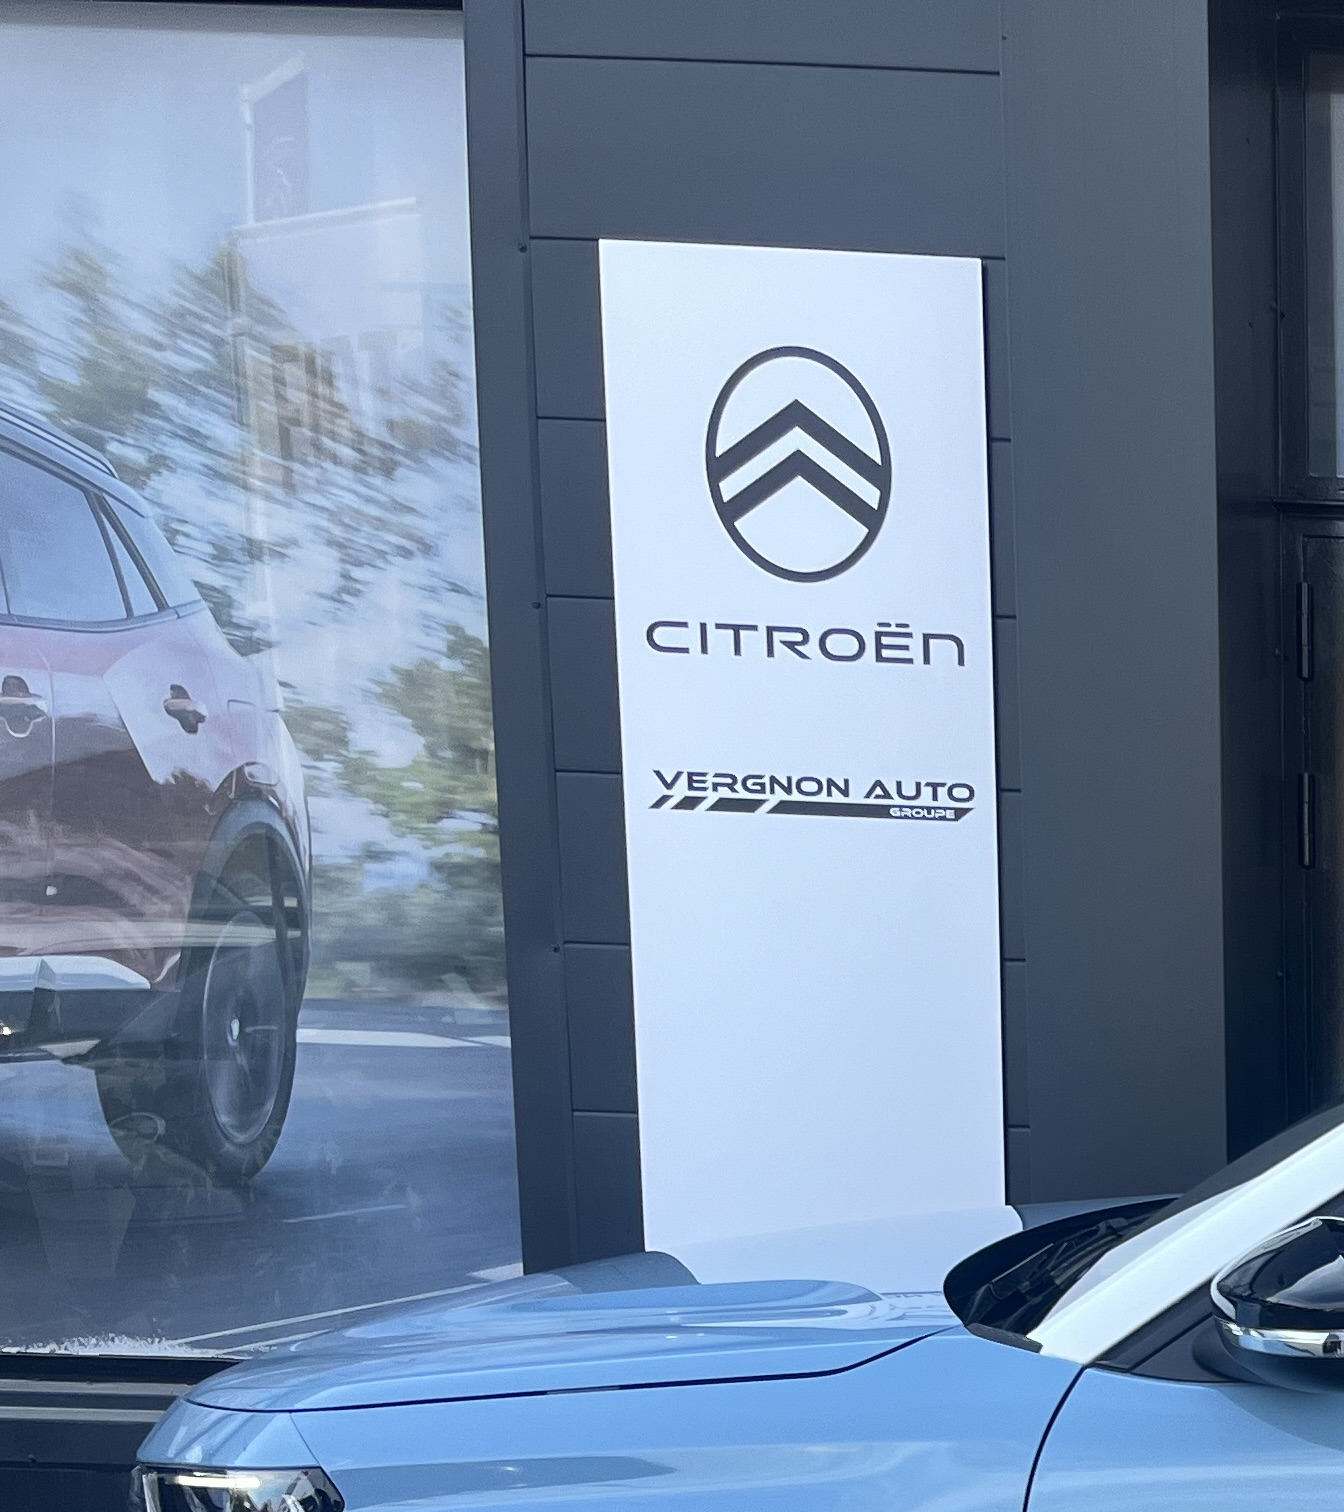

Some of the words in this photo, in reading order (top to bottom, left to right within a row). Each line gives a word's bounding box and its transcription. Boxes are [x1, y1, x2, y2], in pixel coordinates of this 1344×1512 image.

[645, 620, 966, 667] CITROËN
[652, 769, 850, 799] VERGNON
[863, 779, 975, 803] AUTO
[889, 806, 956, 821] GROUPE
